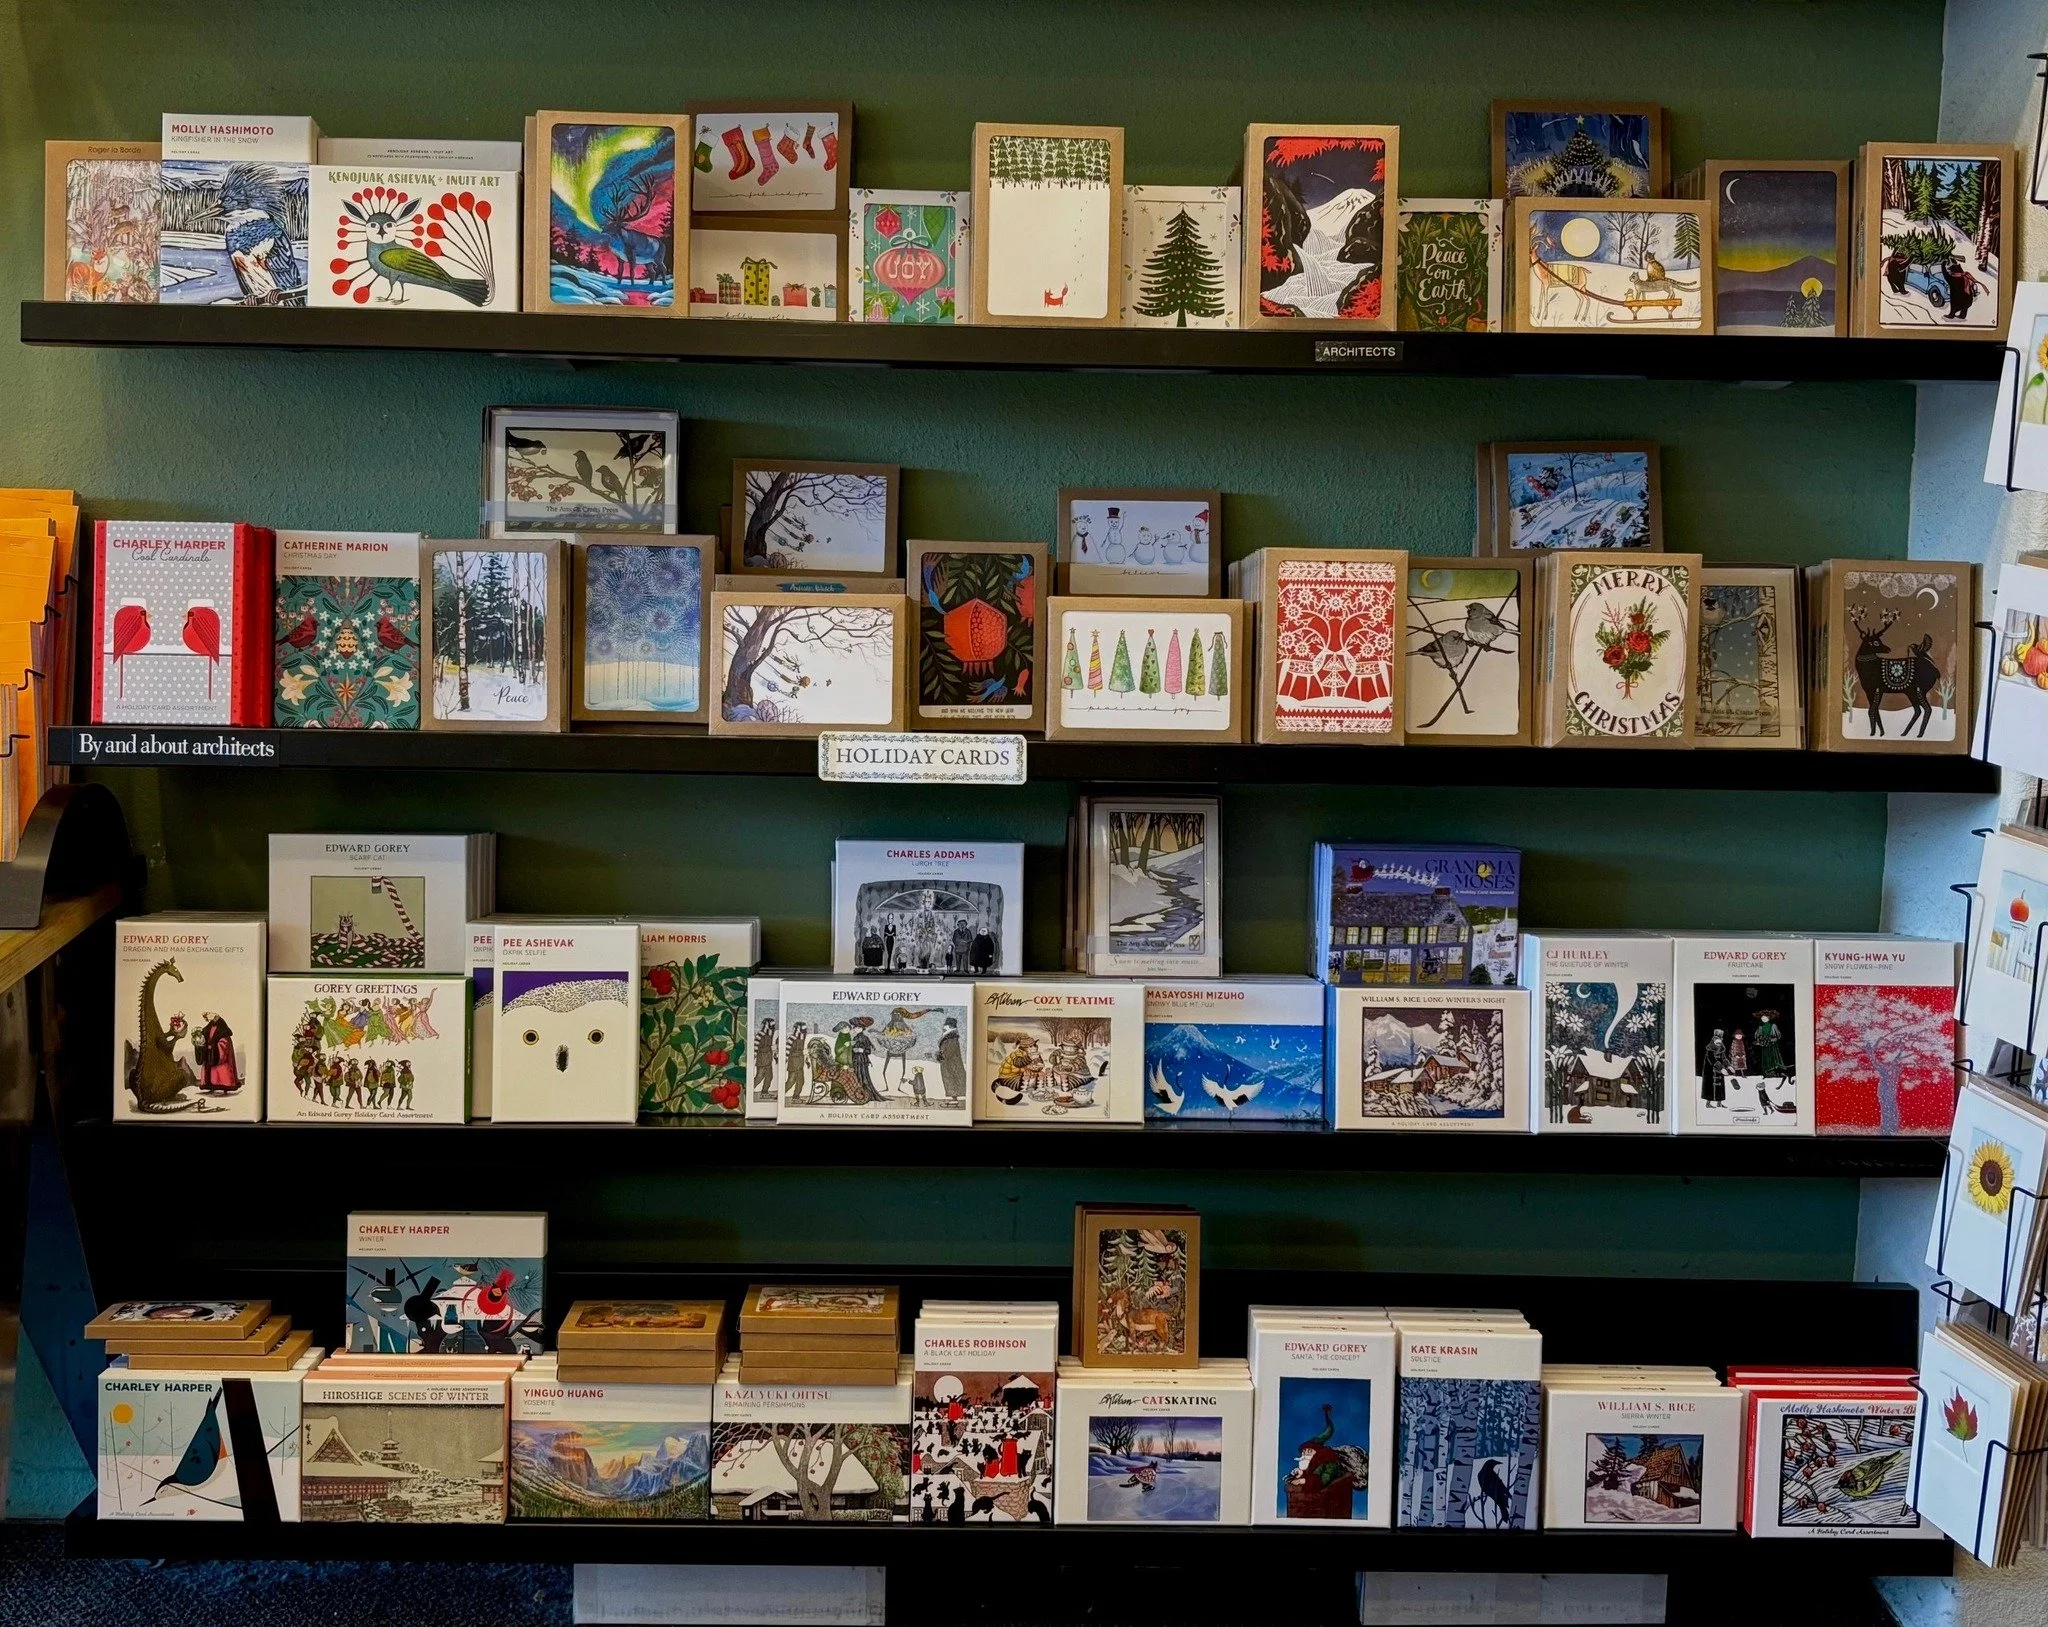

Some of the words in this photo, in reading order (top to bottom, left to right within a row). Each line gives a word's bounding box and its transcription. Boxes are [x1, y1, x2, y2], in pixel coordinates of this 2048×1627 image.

[171, 124, 206, 135] MOLLY
[210, 125, 275, 136] HASHIMOTO
[170, 135, 212, 144] KINGFISHER
[213, 136, 221, 144] IN
[222, 136, 237, 144] THE
[87, 146, 110, 156] Roger
[328, 171, 385, 185] KENOJUAK
[387, 172, 437, 187] ASHEVAK
[446, 175, 476, 186] INUIT
[480, 176, 500, 187] ART
[1415, 243, 1468, 269] Peace
[888, 260, 931, 280] JOY
[1433, 268, 1450, 281] on
[1418, 279, 1472, 305] Earth
[1322, 347, 1396, 357] ARCHITECTS
[113, 539, 171, 549] CHARLEY
[174, 540, 226, 550] HARPER
[284, 541, 343, 551] CATHERINE
[346, 542, 388, 552] MARION
[132, 548, 157, 561] Cool
[160, 547, 211, 562] Cardinals
[1592, 570, 1671, 597] MERRY
[493, 685, 528, 705] Peace
[1574, 691, 1681, 734] CHRISTMAS
[79, 733, 103, 760] By
[105, 734, 137, 754] and
[141, 734, 189, 755] about
[192, 736, 275, 757] architects
[836, 747, 937, 764] HOLIDAY
[940, 749, 1010, 766] CARDS
[325, 844, 370, 853] EDWARD
[374, 844, 410, 853] GOREY
[886, 849, 931, 858] CHARLES
[933, 850, 975, 859] ADDAMS
[1425, 859, 1515, 875] GRANDMA
[1454, 874, 1515, 889] MOSES
[123, 935, 169, 944] EDWARD
[172, 935, 209, 944] GOREY
[473, 935, 492, 944] PEE
[503, 938, 521, 947] PEE
[525, 938, 574, 947] ASHEVAK
[641, 934, 665, 943] LIAM
[668, 935, 707, 943] MORRIS
[1546, 950, 1559, 959] CJ
[1563, 950, 1610, 960] HURLEY
[1703, 951, 1749, 960] EDWARD
[1751, 951, 1788, 960] GOREY
[1824, 952, 1889, 962] KYUNG-HWA
[1891, 953, 1906, 962] YU
[1727, 961, 1764, 969] FRUITCAKE
[314, 983, 352, 994] GOREY
[355, 984, 418, 994] GREETINGS
[832, 990, 880, 1001] EDWARD
[883, 991, 921, 1001] GOREY
[1147, 990, 1203, 999] MASAYOSHI
[1206, 991, 1245, 1000] MIZUHO
[1033, 996, 1061, 1005] COZY
[1066, 996, 1115, 1005] TEATIME
[359, 1225, 406, 1234] CHARLEY
[409, 1226, 450, 1235] HARPER
[924, 1339, 970, 1348] CHARLES
[973, 1339, 1027, 1348] ROBINSON
[1284, 1342, 1329, 1352] EDWARD
[1332, 1343, 1368, 1353] GOREY
[1411, 1345, 1437, 1354] KATE
[1440, 1346, 1478, 1355] KRASIN
[104, 1382, 160, 1392] CHARLEY
[164, 1383, 213, 1392] HARPER
[322, 1391, 383, 1400] HIROSHIGE
[388, 1391, 427, 1401] SCENES
[430, 1391, 444, 1401] OF
[447, 1392, 489, 1401] WINTER
[523, 1388, 564, 1398] YINGUO
[567, 1389, 604, 1398] HUANG
[725, 1390, 788, 1399] KAZUYUKI
[792, 1390, 831, 1400] OHTSU
[1142, 1395, 1217, 1406] CATSKATING
[1598, 1401, 1651, 1411] WILLIAM
[1655, 1402, 1665, 1411] S.
[1669, 1402, 1696, 1412] RICE
[1780, 1403, 1813, 1416] Molly
[1815, 1403, 1865, 1414] Hashimoto
[1867, 1404, 1900, 1415] Winter
[1817, 1528, 1839, 1536] Holiday
